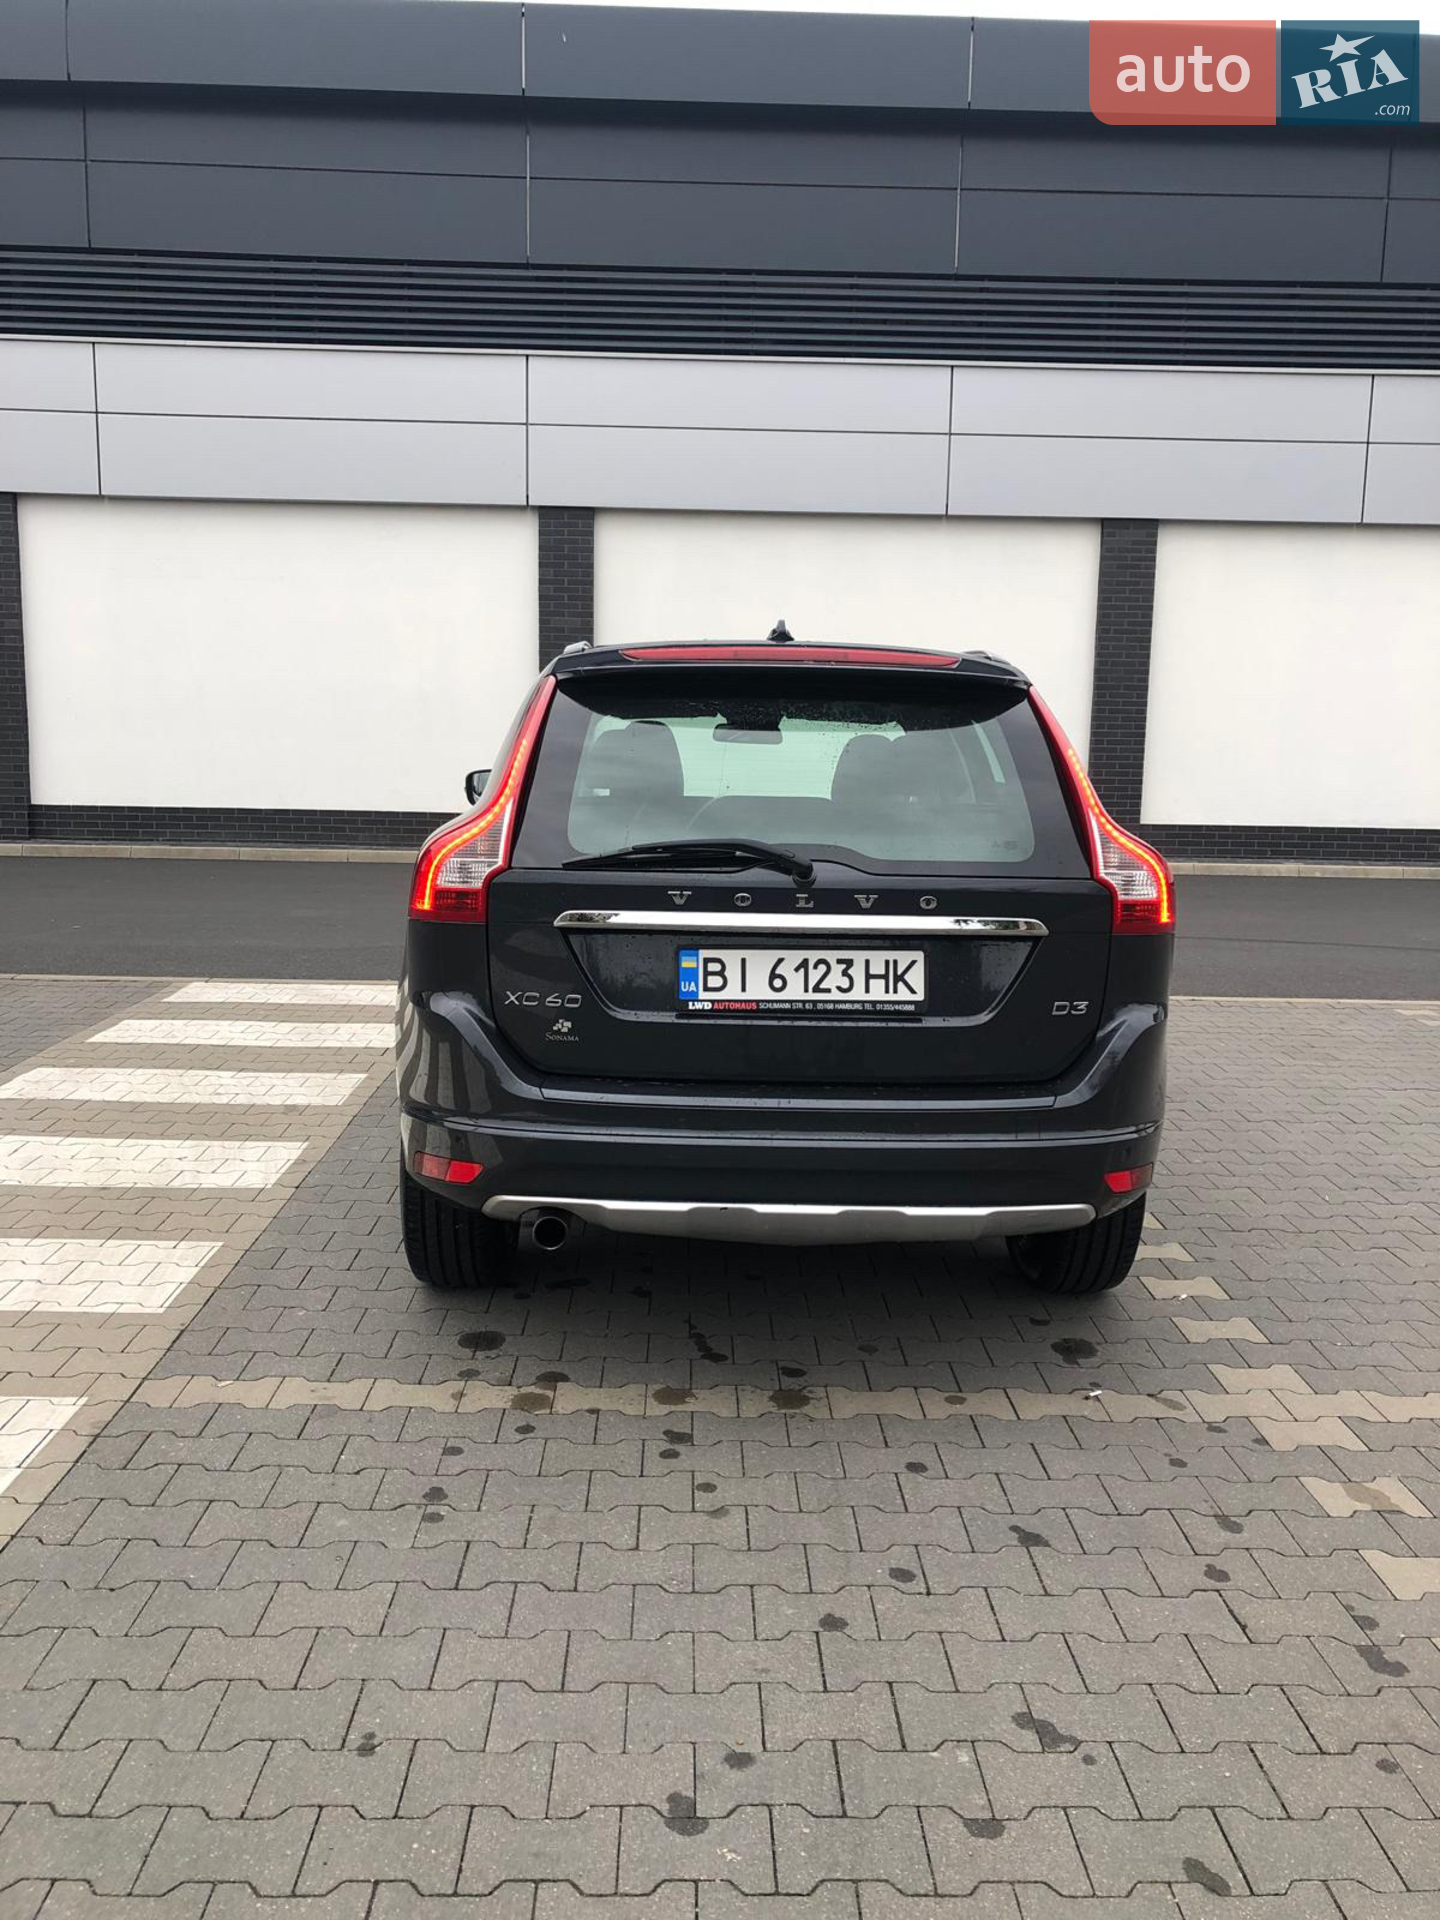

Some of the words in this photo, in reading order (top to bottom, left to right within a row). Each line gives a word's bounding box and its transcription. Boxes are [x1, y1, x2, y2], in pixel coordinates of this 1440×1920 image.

[667, 890, 938, 910] VOLVO
[768, 957, 855, 994] 6123
[864, 959, 919, 995] HK
[681, 981, 697, 992] UA
[713, 1002, 757, 1010] AUTOHAUS
[1051, 1001, 1089, 1015] D3
